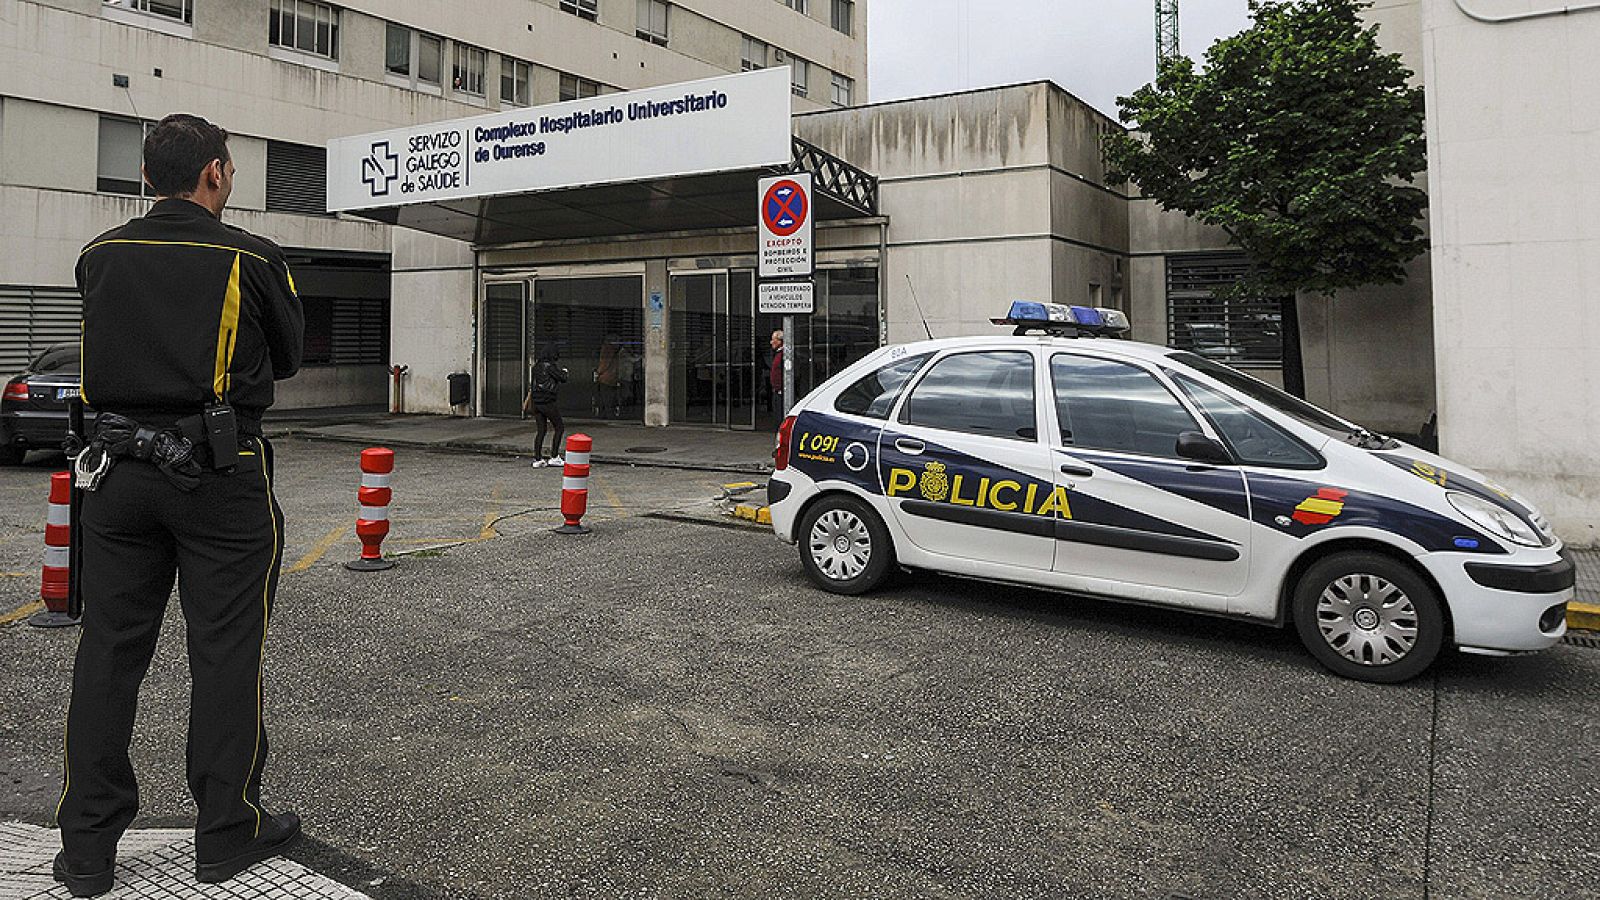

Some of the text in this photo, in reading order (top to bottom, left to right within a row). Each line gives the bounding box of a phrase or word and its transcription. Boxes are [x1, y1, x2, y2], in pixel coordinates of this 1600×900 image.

[474, 90, 727, 143] Complexo Hospitalario Universitario
[408, 130, 461, 153] SERVIZO
[474, 141, 546, 163] de Ourense
[406, 151, 461, 173] GALEGO
[401, 170, 460, 194] de SAÚDE
[764, 248, 800, 256] BOMBEIROS
[767, 238, 802, 247] EXCEPTO
[810, 434, 840, 453] 091
